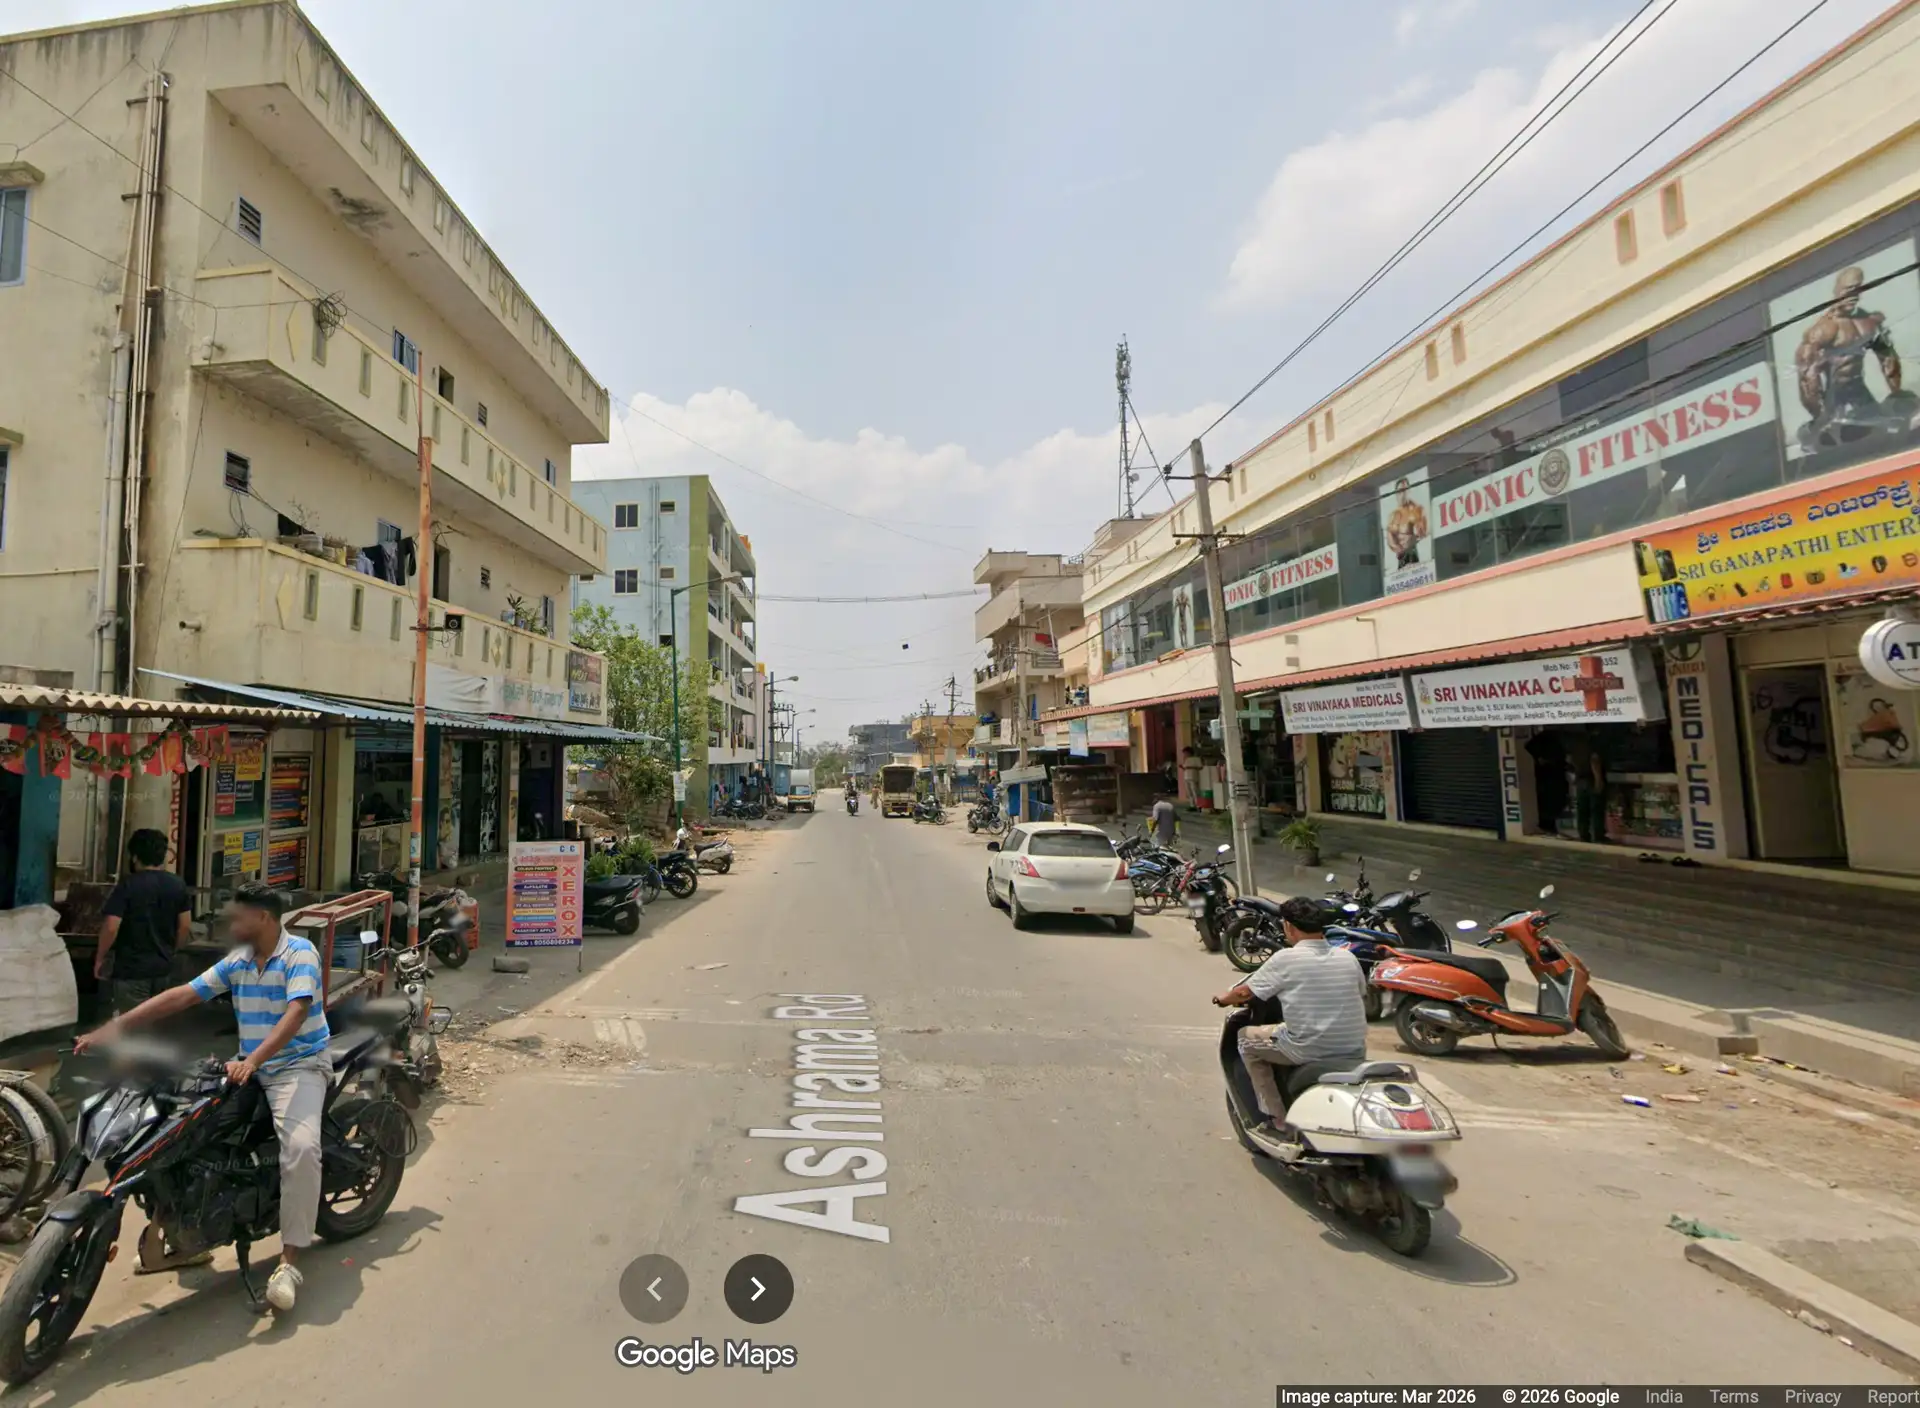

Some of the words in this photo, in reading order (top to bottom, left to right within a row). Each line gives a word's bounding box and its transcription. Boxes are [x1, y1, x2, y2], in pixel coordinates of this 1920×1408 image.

[1439, 467, 1535, 528] ICONIC
[1577, 377, 1763, 478] FITNESS
[1271, 550, 1334, 590] FITNESS
[1678, 563, 1705, 582] SRI
[1710, 533, 1830, 575] GANAPATHI
[1836, 514, 1920, 549] ENTER
[1292, 701, 1307, 714] SRI
[1308, 697, 1351, 712] VINAYAKA
[1352, 692, 1404, 709] MEDICALS
[1433, 686, 1458, 702] SRI
[1460, 678, 1545, 701] VINAYAKA
[1676, 677, 1715, 850] MEDICALS
[561, 866, 577, 936] XEROX
